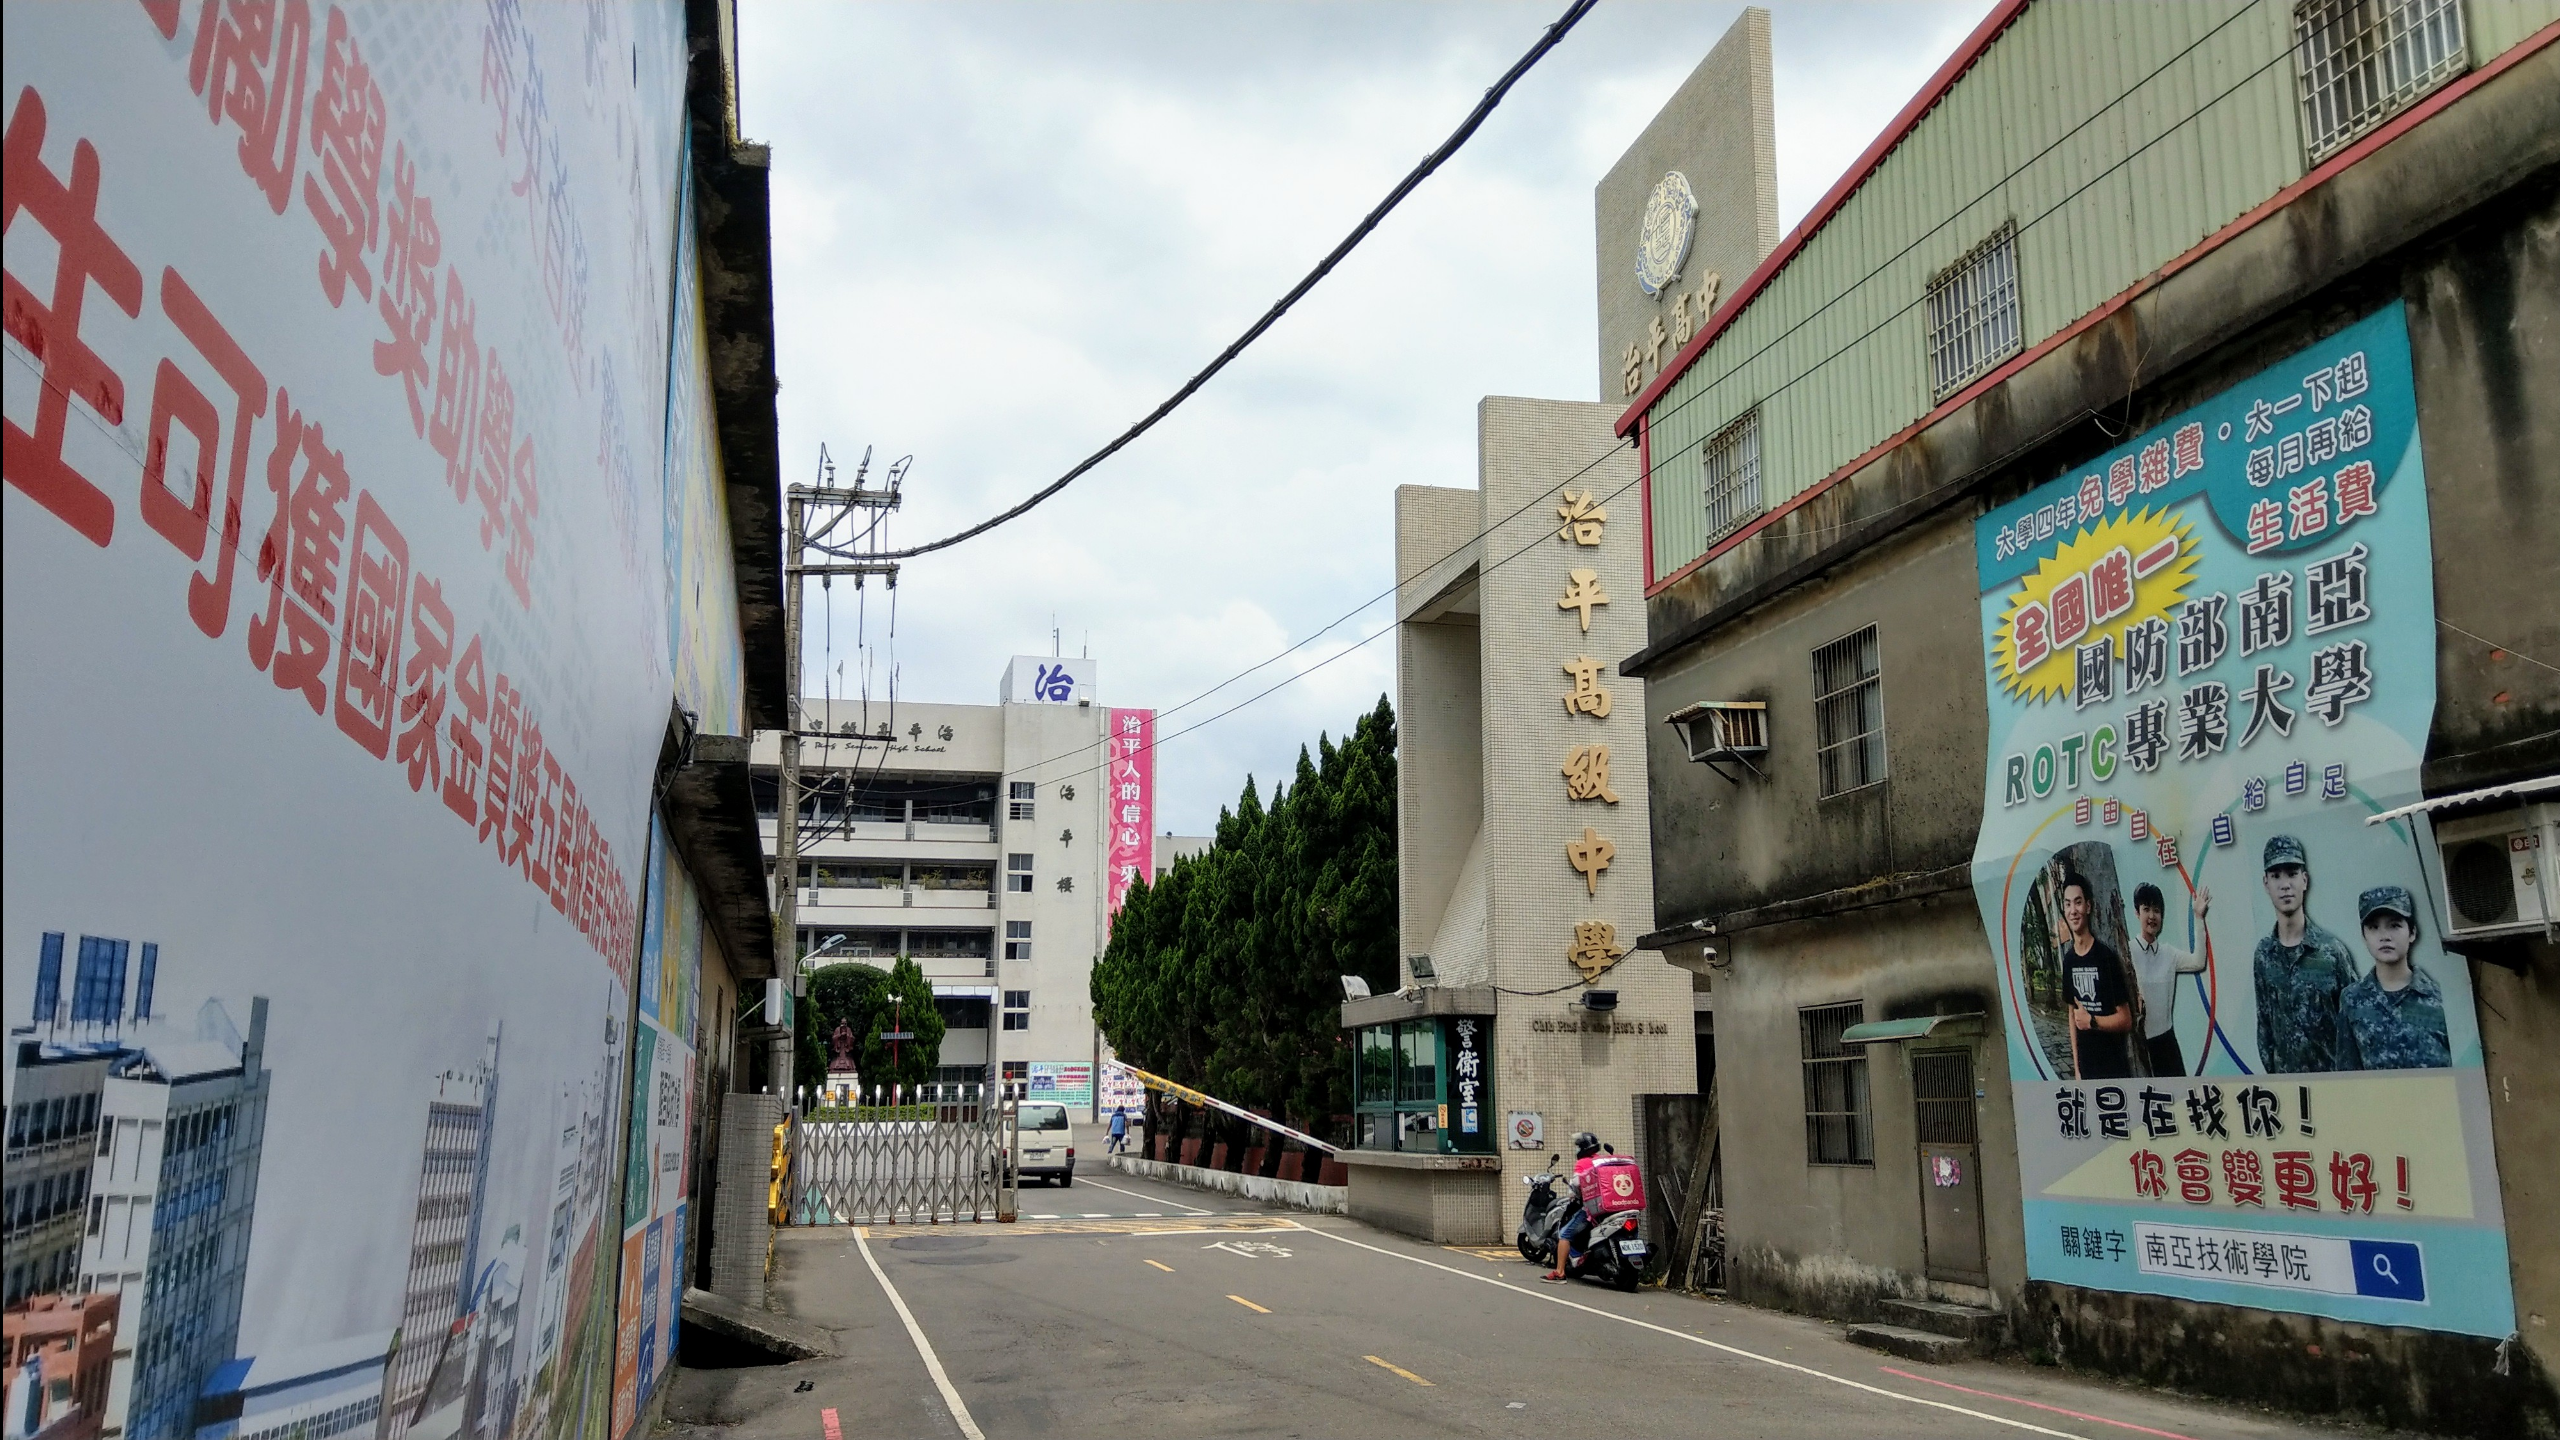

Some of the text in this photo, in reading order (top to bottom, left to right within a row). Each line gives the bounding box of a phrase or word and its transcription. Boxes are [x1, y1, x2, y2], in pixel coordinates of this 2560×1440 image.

[2245, 351, 2368, 443] 大一下起
[2247, 404, 2372, 487] 每月再給
[2247, 460, 2376, 555] 生活費
[2014, 534, 2181, 674] 全國唯一
[2074, 542, 2370, 711] 國防部南亞
[1034, 663, 1075, 702] 治
[914, 745, 947, 753] School
[1121, 714, 1142, 847] 治平人的信心
[1557, 489, 1624, 984] 治平高級中學
[1456, 1019, 1480, 1108] 警衛室
[2060, 1225, 2127, 1263] 關鍵字
[2144, 1232, 2312, 1283] 南亞技術學院
